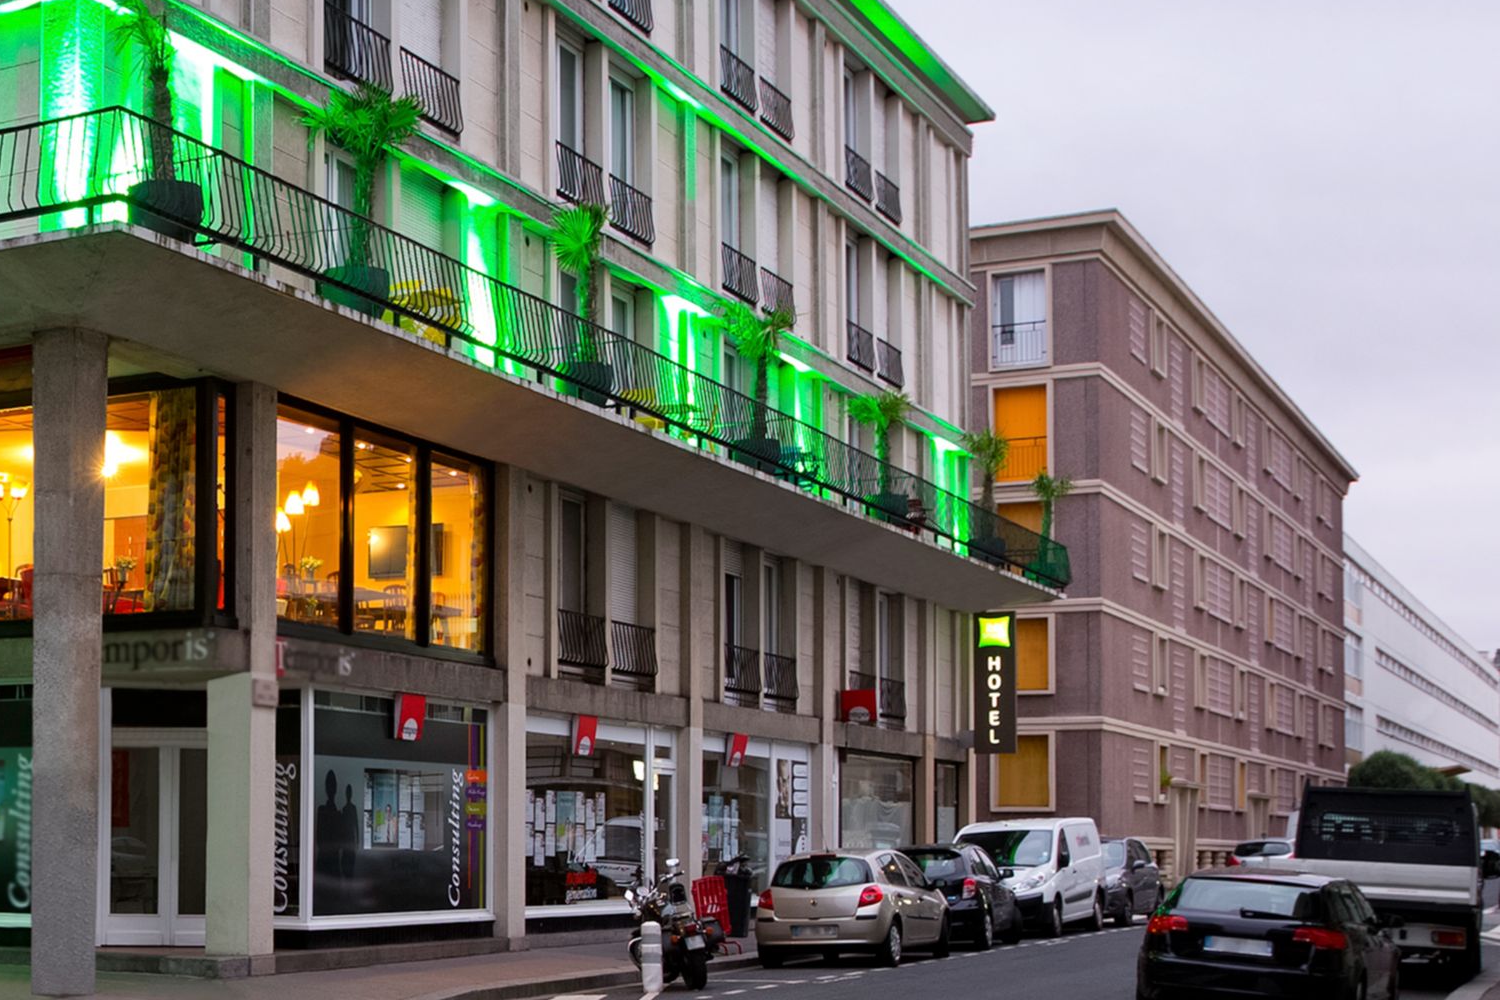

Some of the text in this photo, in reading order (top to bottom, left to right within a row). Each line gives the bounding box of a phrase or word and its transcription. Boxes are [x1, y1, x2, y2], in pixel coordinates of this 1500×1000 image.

[104, 632, 208, 670] mporis
[987, 656, 1002, 744] HOTEL
[8, 753, 33, 909] Consulting
[448, 768, 463, 907] Consulting
